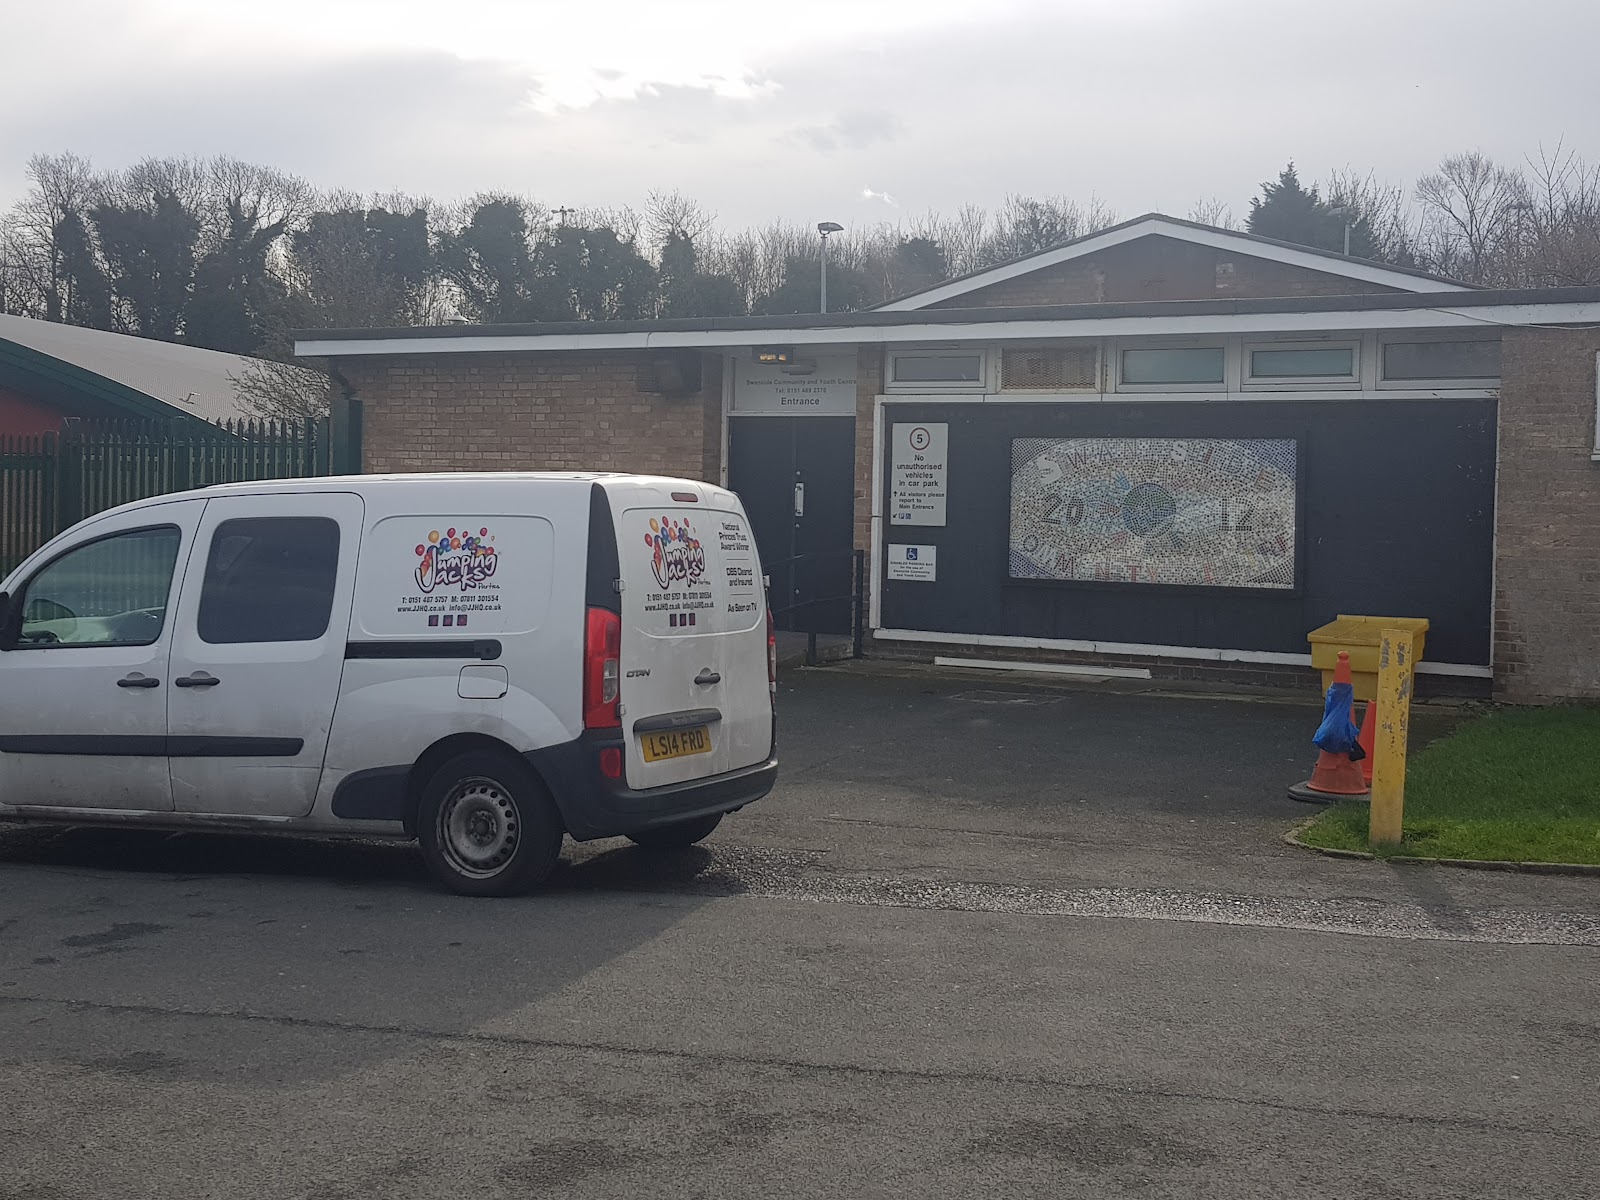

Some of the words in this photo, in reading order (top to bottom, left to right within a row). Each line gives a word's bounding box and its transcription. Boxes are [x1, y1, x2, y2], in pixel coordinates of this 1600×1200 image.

[781, 397, 820, 406] Entrance
[916, 434, 922, 444] 5
[923, 480, 938, 488] park
[1041, 492, 1084, 527] 20
[1218, 496, 1255, 532] 12
[398, 604, 446, 612] www.JJHQ.co.uk
[448, 604, 502, 612] info@JJHQ.co.uk
[728, 604, 734, 612] As
[751, 602, 758, 610] TV
[650, 734, 679, 757] LS14
[680, 730, 704, 752] FRD
